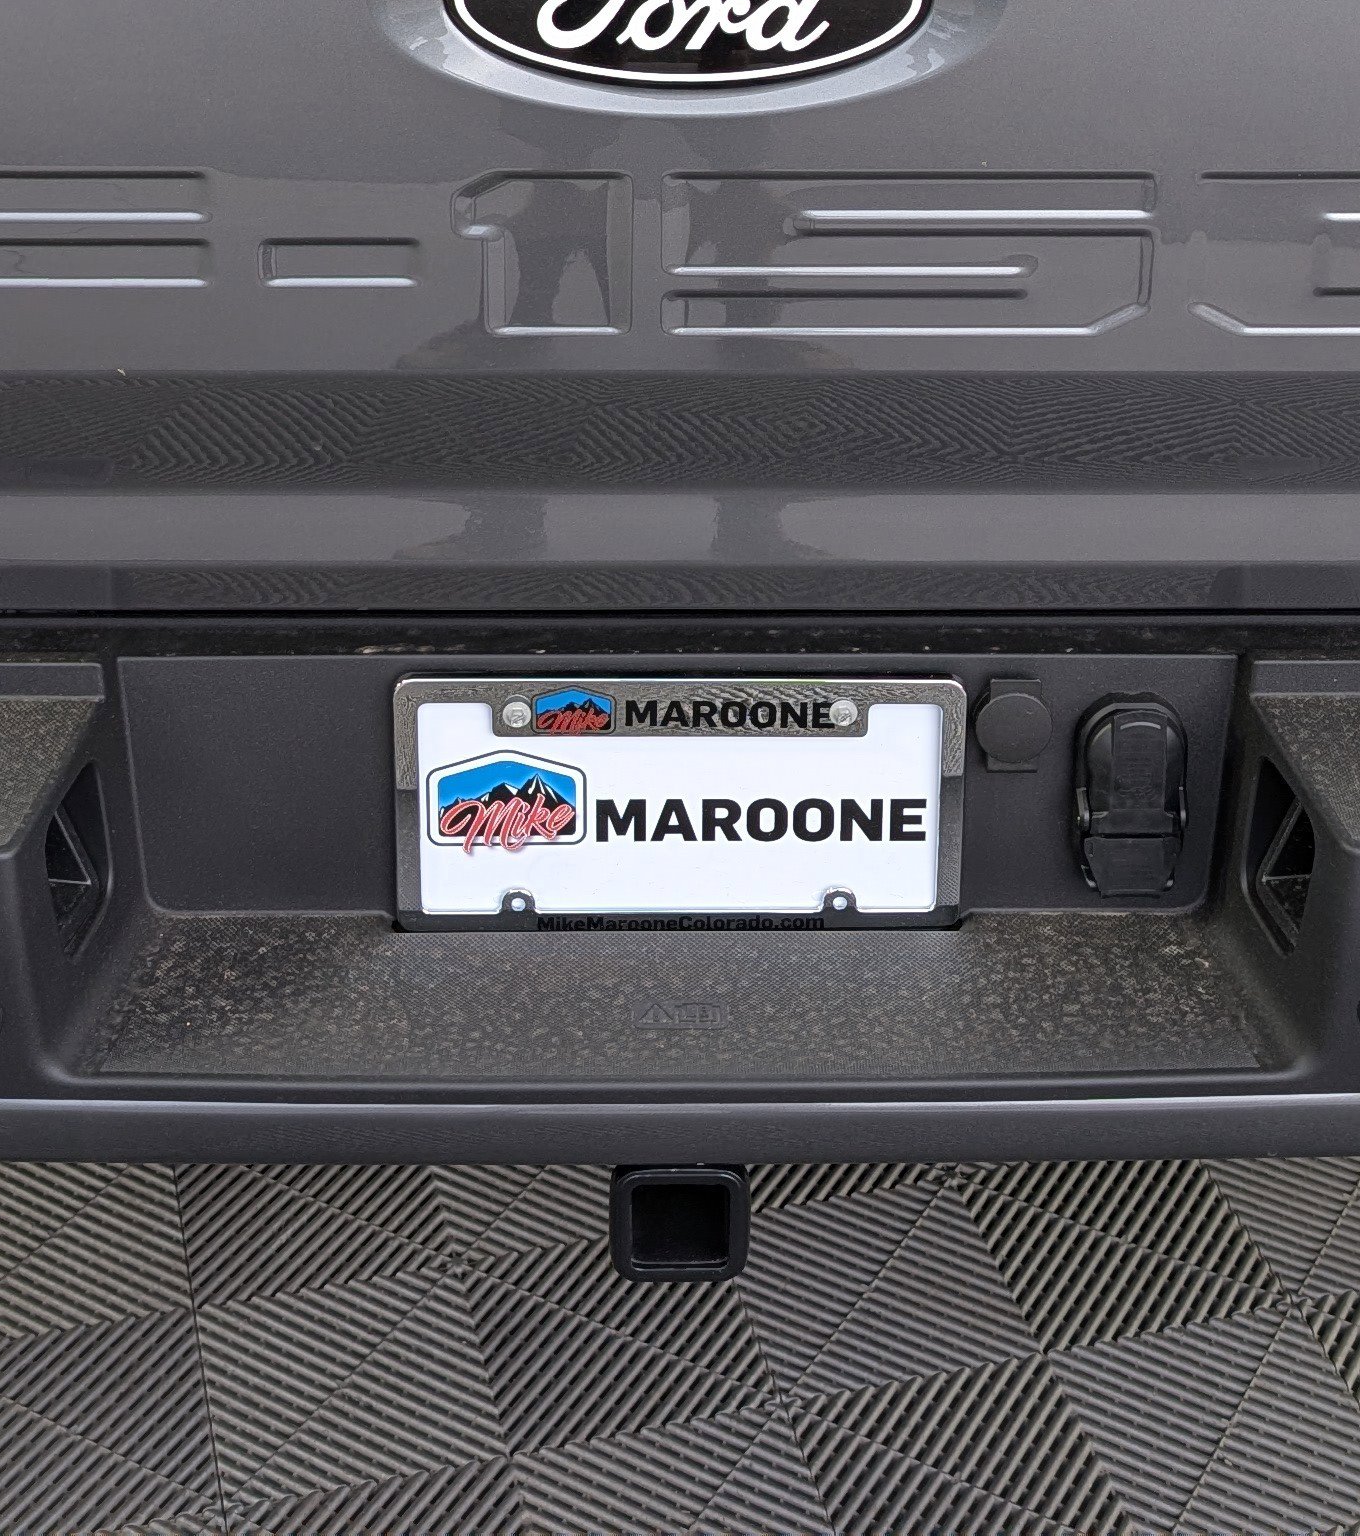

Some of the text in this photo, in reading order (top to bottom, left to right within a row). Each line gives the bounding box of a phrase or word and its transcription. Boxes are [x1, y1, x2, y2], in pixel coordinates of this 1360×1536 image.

[538, 700, 836, 736] Mike MAROONE
[439, 793, 927, 854] Mike MAROONE
[537, 914, 825, 930] MikeMarooneColorado.com
